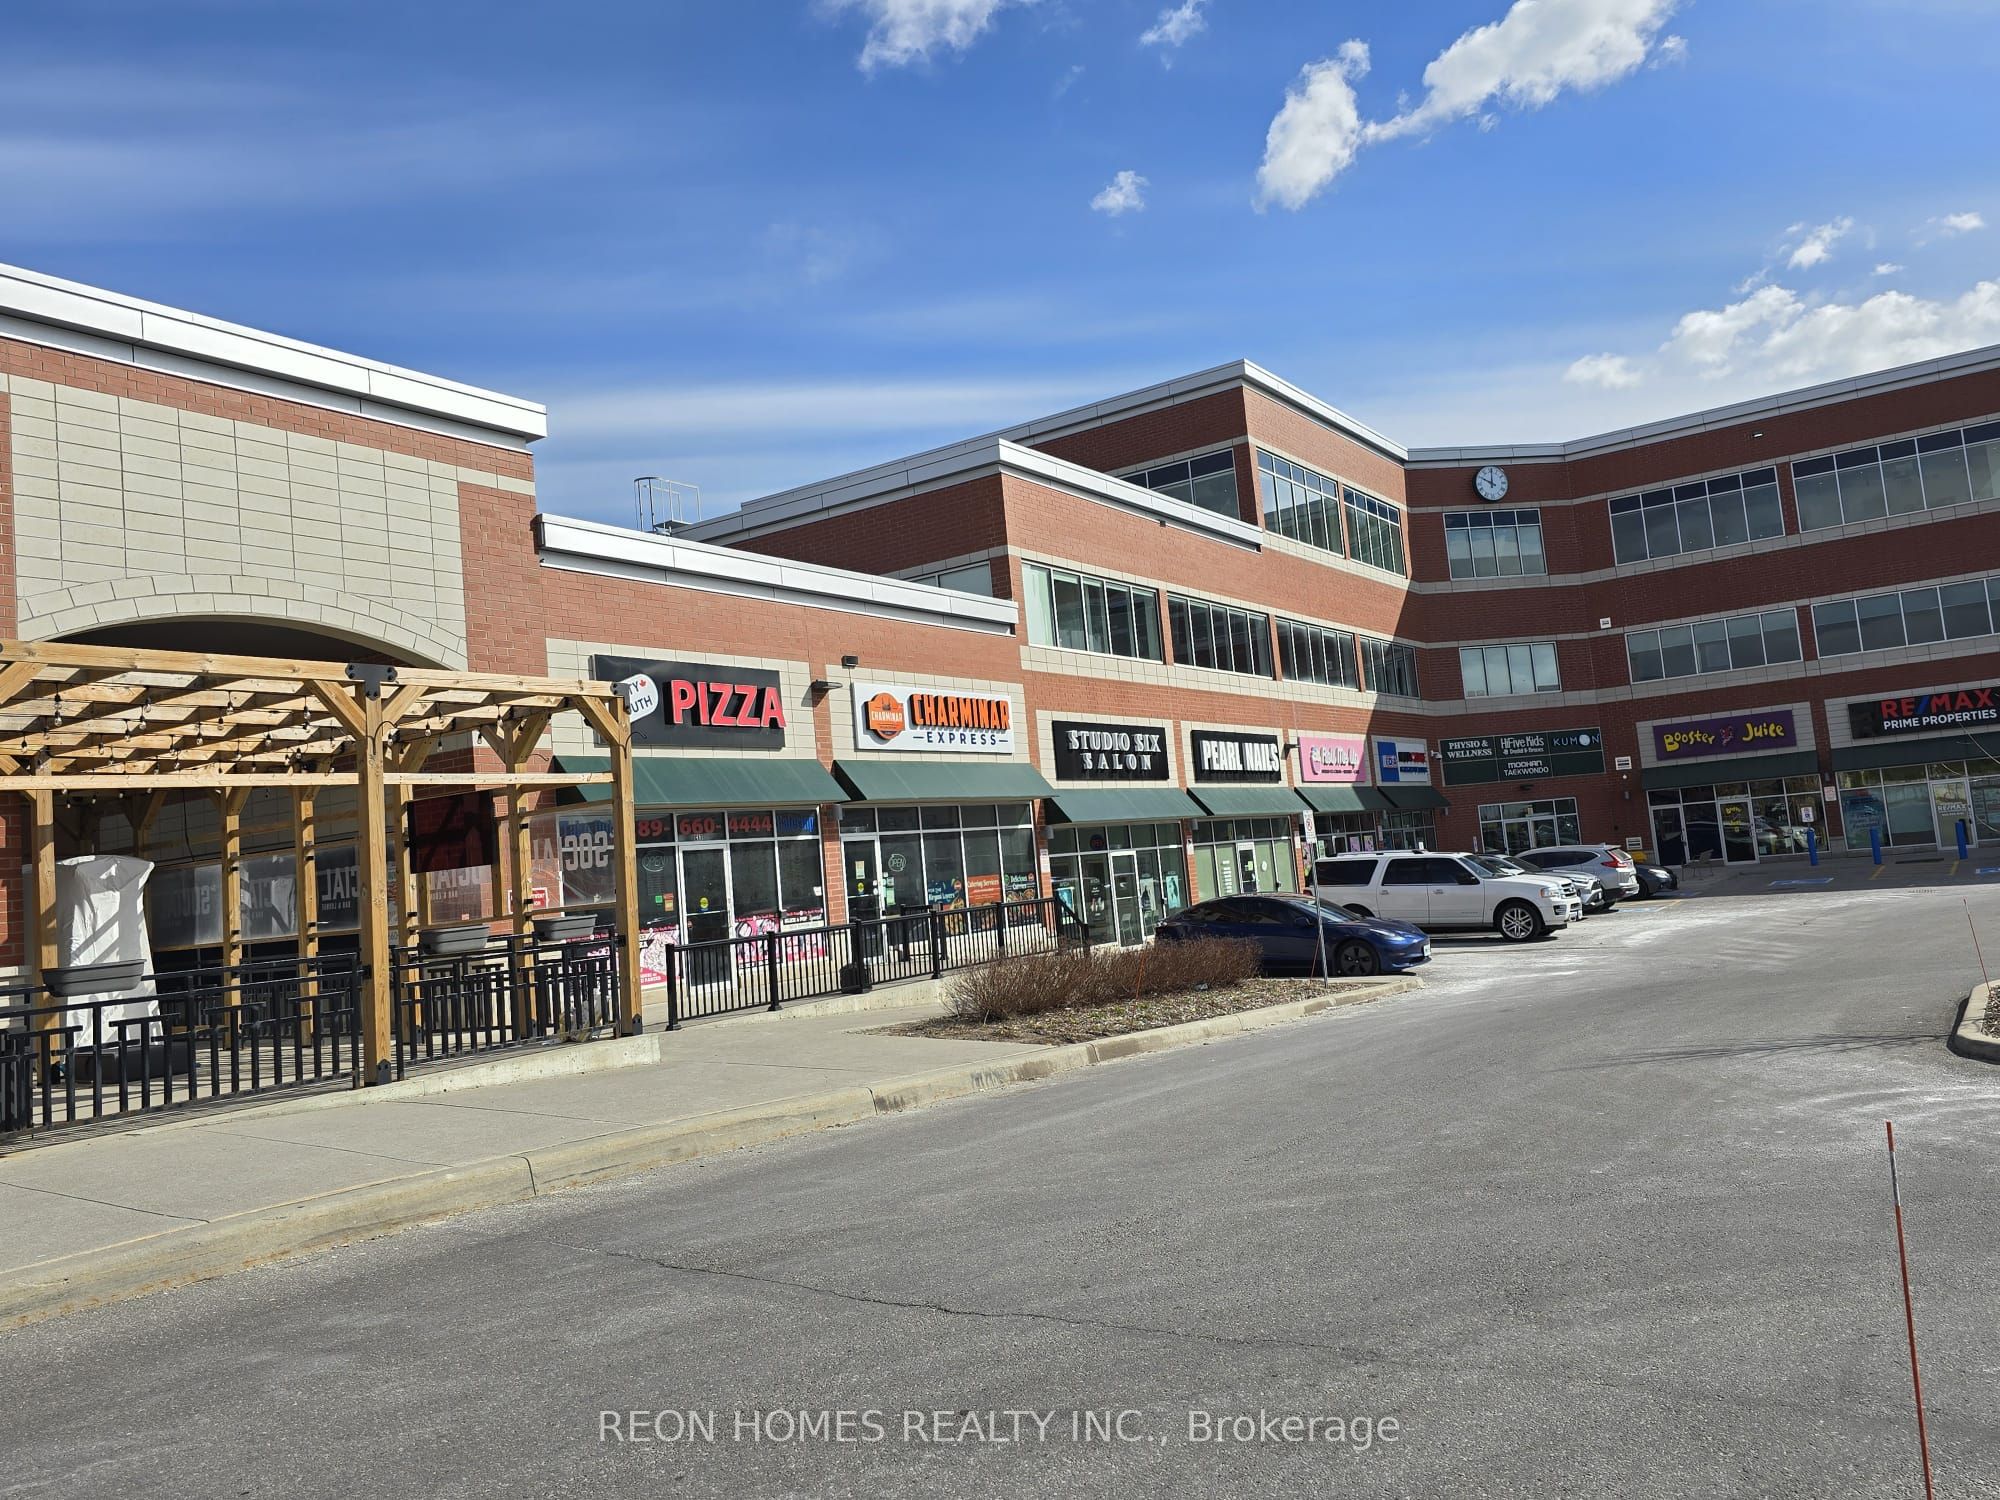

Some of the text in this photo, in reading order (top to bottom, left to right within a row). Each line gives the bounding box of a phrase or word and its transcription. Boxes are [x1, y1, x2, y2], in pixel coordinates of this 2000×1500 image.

[671, 679, 786, 728] PIZZA
[910, 694, 1010, 730] CHARMINAR
[1880, 688, 1995, 720] RE/MAX
[871, 711, 903, 722] CHARMINAR
[1883, 709, 1997, 730] PRIME PROPERTIES
[927, 732, 997, 745] EXPRESS
[1553, 734, 1599, 747] KUMON
[1742, 723, 1784, 741] Juice
[1066, 730, 1161, 752] STUDIO SIX
[1449, 739, 1489, 750] PHYSIO &
[1526, 735, 1544, 747] Kids
[1081, 753, 1152, 770] SALON
[1201, 740, 1279, 771] PEARL NAILS
[1447, 749, 1492, 759] WELLNESS
[1504, 766, 1549, 776] TAEKWONDO
[638, 819, 671, 837] 89-
[729, 815, 772, 833] 4444
